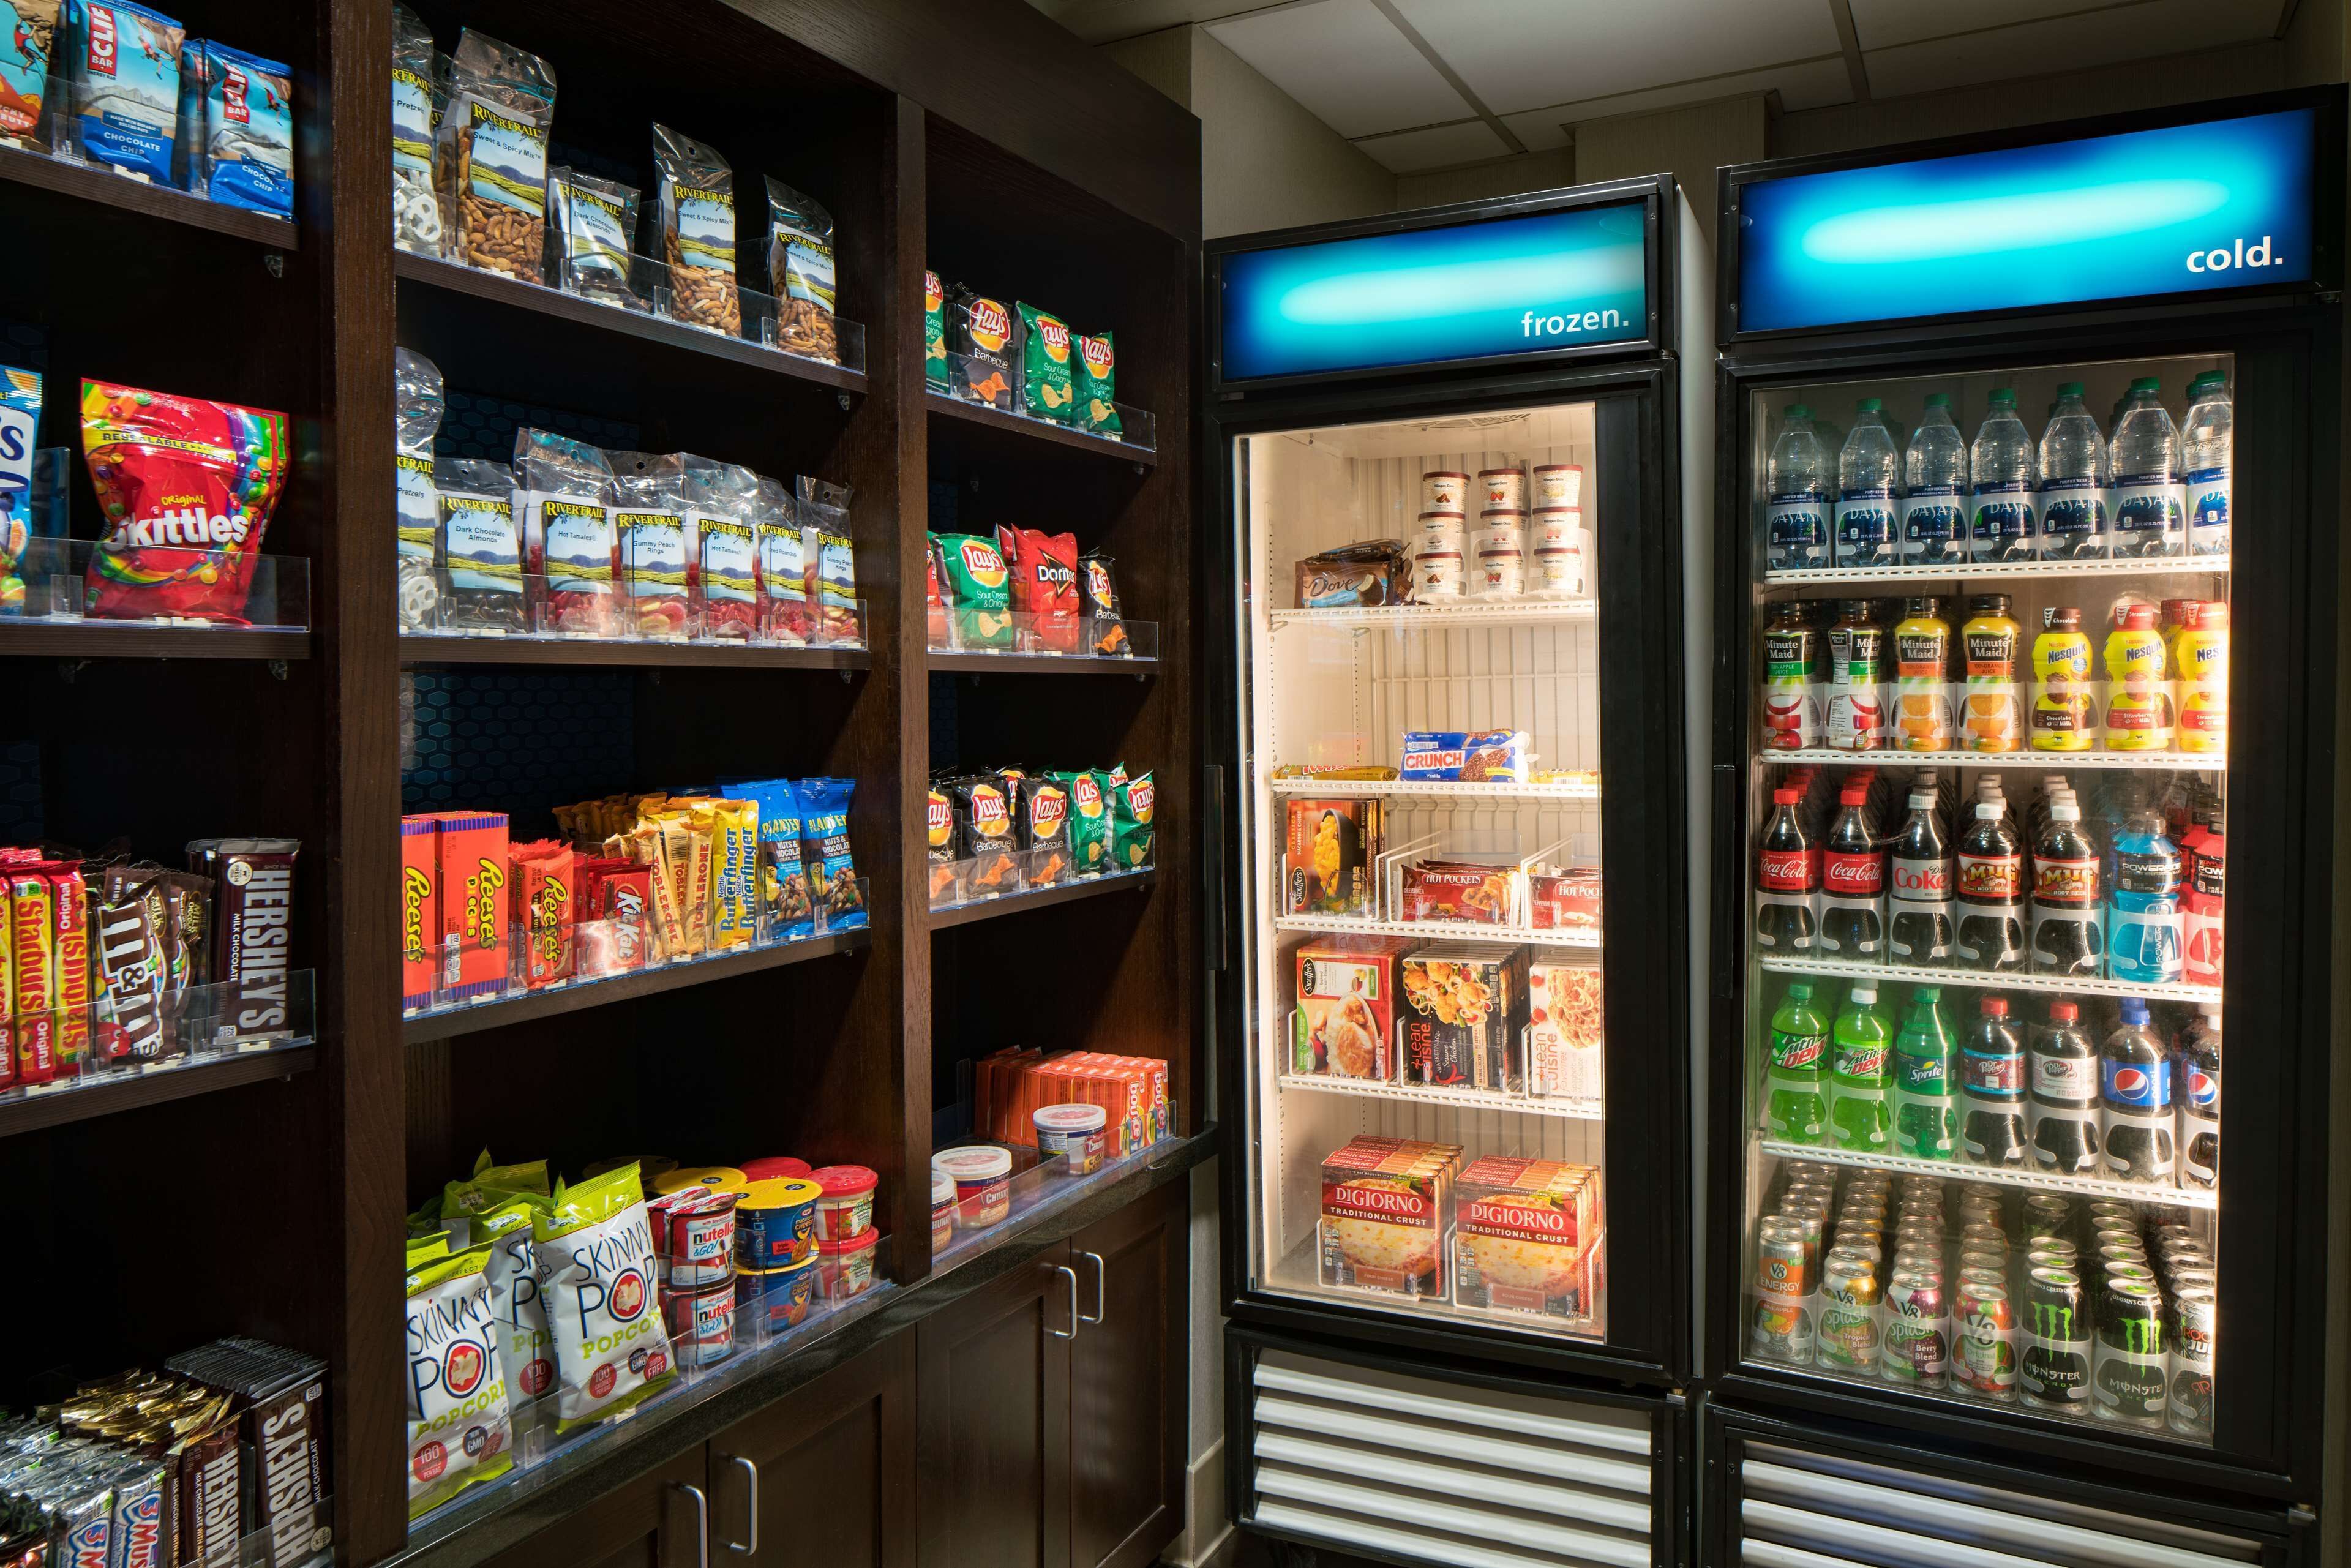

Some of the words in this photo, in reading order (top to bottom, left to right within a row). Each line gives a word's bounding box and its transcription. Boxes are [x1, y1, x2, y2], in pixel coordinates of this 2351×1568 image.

[92, 55, 113, 68] BAR
[228, 107, 247, 116] BAR
[103, 132, 160, 152] CHOCOLATE
[474, 132, 495, 143] Sweet
[503, 143, 522, 156] Spicy
[253, 179, 273, 192] CHIP
[574, 211, 590, 222] Dark
[678, 211, 696, 220] Sweet
[702, 216, 718, 225] Spicy
[2186, 236, 2283, 273] cold.
[1521, 309, 1629, 337] frozen.
[975, 348, 1008, 369] Barbecue
[1044, 362, 1054, 372] Sour
[1052, 374, 1066, 383] Onion
[456, 525, 473, 534] Dark
[474, 527, 505, 538] Chocolate
[468, 534, 498, 544] Almonds
[632, 541, 656, 550] Gummy
[827, 556, 839, 565] Gummy
[961, 546, 1003, 572] Lay's
[835, 563, 846, 572] Rings
[977, 590, 991, 599] Sour
[992, 591, 1008, 601] Cream
[1766, 640, 1798, 648] Minute
[1902, 640, 1940, 649] Minute
[1971, 638, 2008, 647] Minute
[2126, 639, 2162, 662] Nesquik
[1770, 648, 1793, 658] Maid
[1907, 649, 1933, 658] Maid
[1975, 648, 2002, 656] Maid
[2048, 642, 2087, 664] Nesquik
[1405, 752, 1463, 770] CRUNCH
[1033, 798, 1064, 823] Lay's
[977, 839, 1012, 852] Barbecue
[1033, 840, 1063, 851] Barbecue
[1760, 858, 1809, 878] Coca-Cola
[1830, 862, 1881, 881] Coca-Cola
[1970, 866, 2016, 881] MUG
[720, 827, 738, 931] Butterfinger
[740, 827, 757, 928] Butterfinger
[1444, 874, 1481, 884] POCKETS
[1895, 867, 1948, 890] Coke
[2045, 869, 2094, 885] MUG
[693, 844, 709, 930] TOBLERONE
[1295, 872, 1304, 901] Stouffer's
[1559, 885, 1578, 896] HOT
[60, 883, 71, 929] original
[479, 858, 504, 950] Reese's
[405, 866, 430, 963] Reese's
[544, 876, 568, 962] Reese's
[238, 869, 291, 1029] HERSHEY'S
[1304, 962, 1313, 992] Stouffer's
[36, 1021, 50, 1070] original
[1910, 1065, 1941, 1081] Sprite
[1979, 1062, 2003, 1073] Pepper
[2046, 1063, 2068, 1073] Pepper
[1330, 1206, 1394, 1223] TRADITIONAL
[1396, 1215, 1427, 1226] CRUST
[1465, 1224, 1532, 1240] TRADITIONAL
[1535, 1232, 1569, 1244] CRUST
[572, 1216, 651, 1281] SKINNY
[1771, 1262, 1785, 1278] V8
[1760, 1277, 1801, 1291] ENERGY
[576, 1255, 656, 1339] POP
[1965, 1312, 1996, 1345] V8
[1916, 1345, 1937, 1354] Berry
[1967, 1348, 1996, 1359] Original
[648, 1363, 665, 1378] FREE
[140, 1501, 158, 1517] 3
